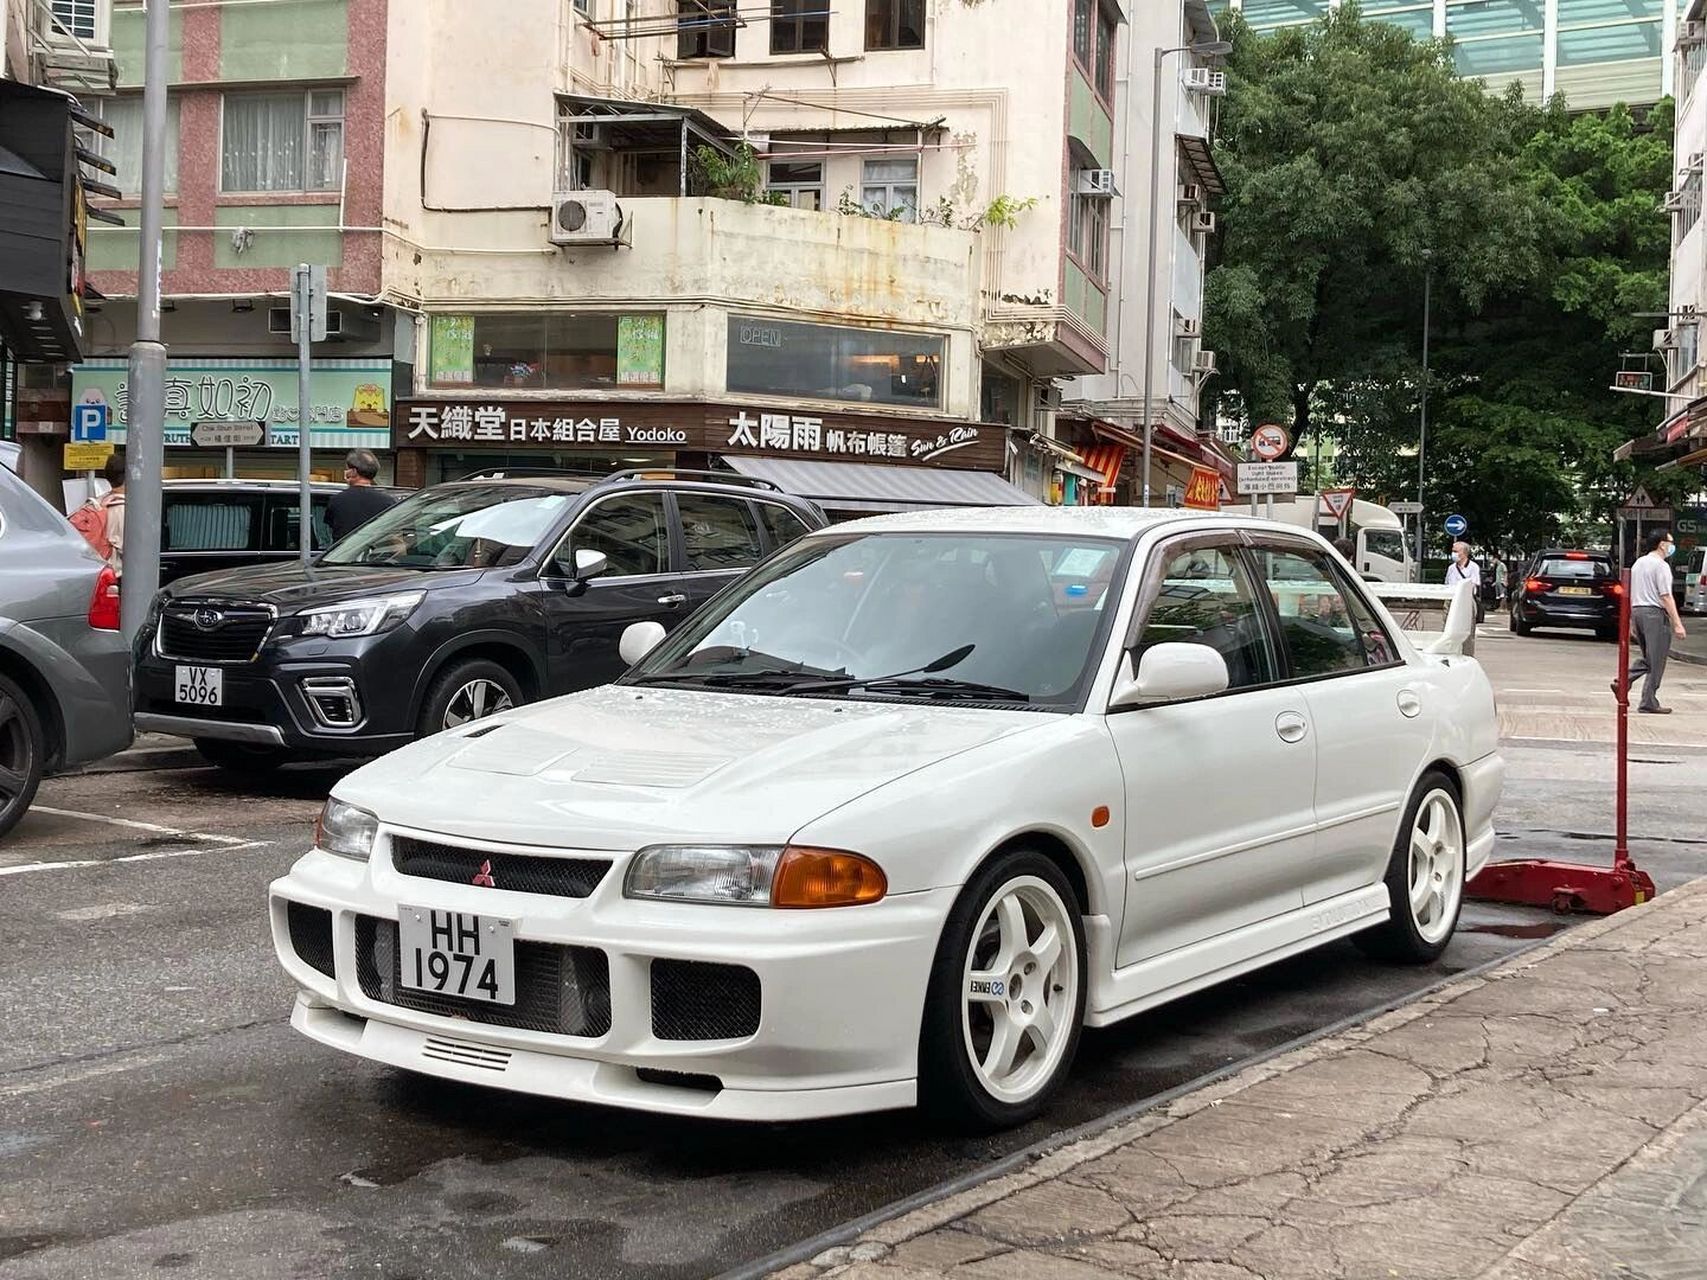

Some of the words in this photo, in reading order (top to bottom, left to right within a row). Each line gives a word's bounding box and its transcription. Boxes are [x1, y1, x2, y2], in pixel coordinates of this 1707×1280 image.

[742, 328, 778, 346] OPEN
[81, 409, 101, 438] P
[164, 433, 191, 443] RUTH
[407, 406, 505, 441] 天織堂
[509, 418, 621, 442] 日本組合屋
[627, 427, 686, 443] Yodoko
[727, 411, 823, 451] 太陽雨
[910, 439, 935, 457] Sun
[936, 435, 947, 448] &
[949, 427, 978, 444] Rain
[189, 667, 207, 686] VX
[179, 684, 217, 704] 5096
[430, 910, 480, 955] HH
[415, 948, 498, 1000] 1974
